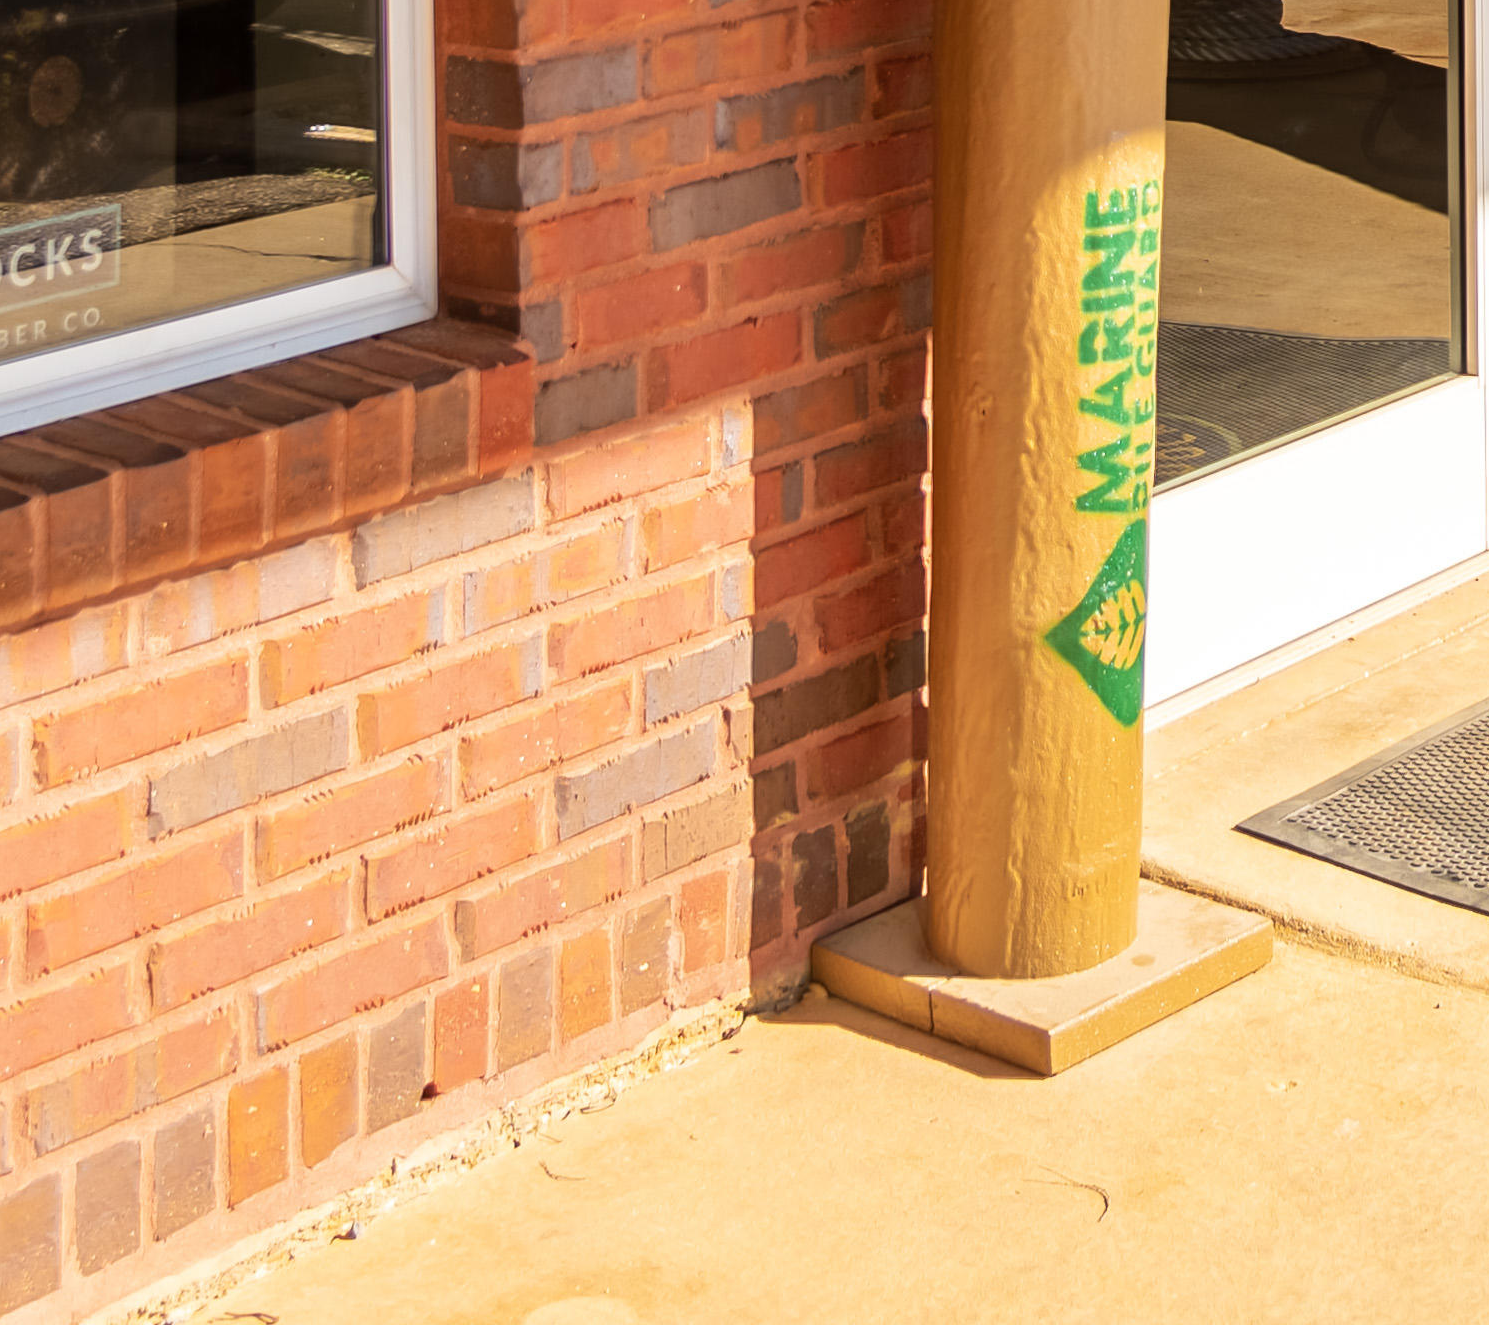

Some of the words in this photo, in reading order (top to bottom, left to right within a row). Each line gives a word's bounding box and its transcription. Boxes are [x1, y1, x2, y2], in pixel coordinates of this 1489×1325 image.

[62, 306, 105, 336] CO.
[1074, 187, 1139, 514] MARINE
[1135, 178, 1161, 379] GUARD
